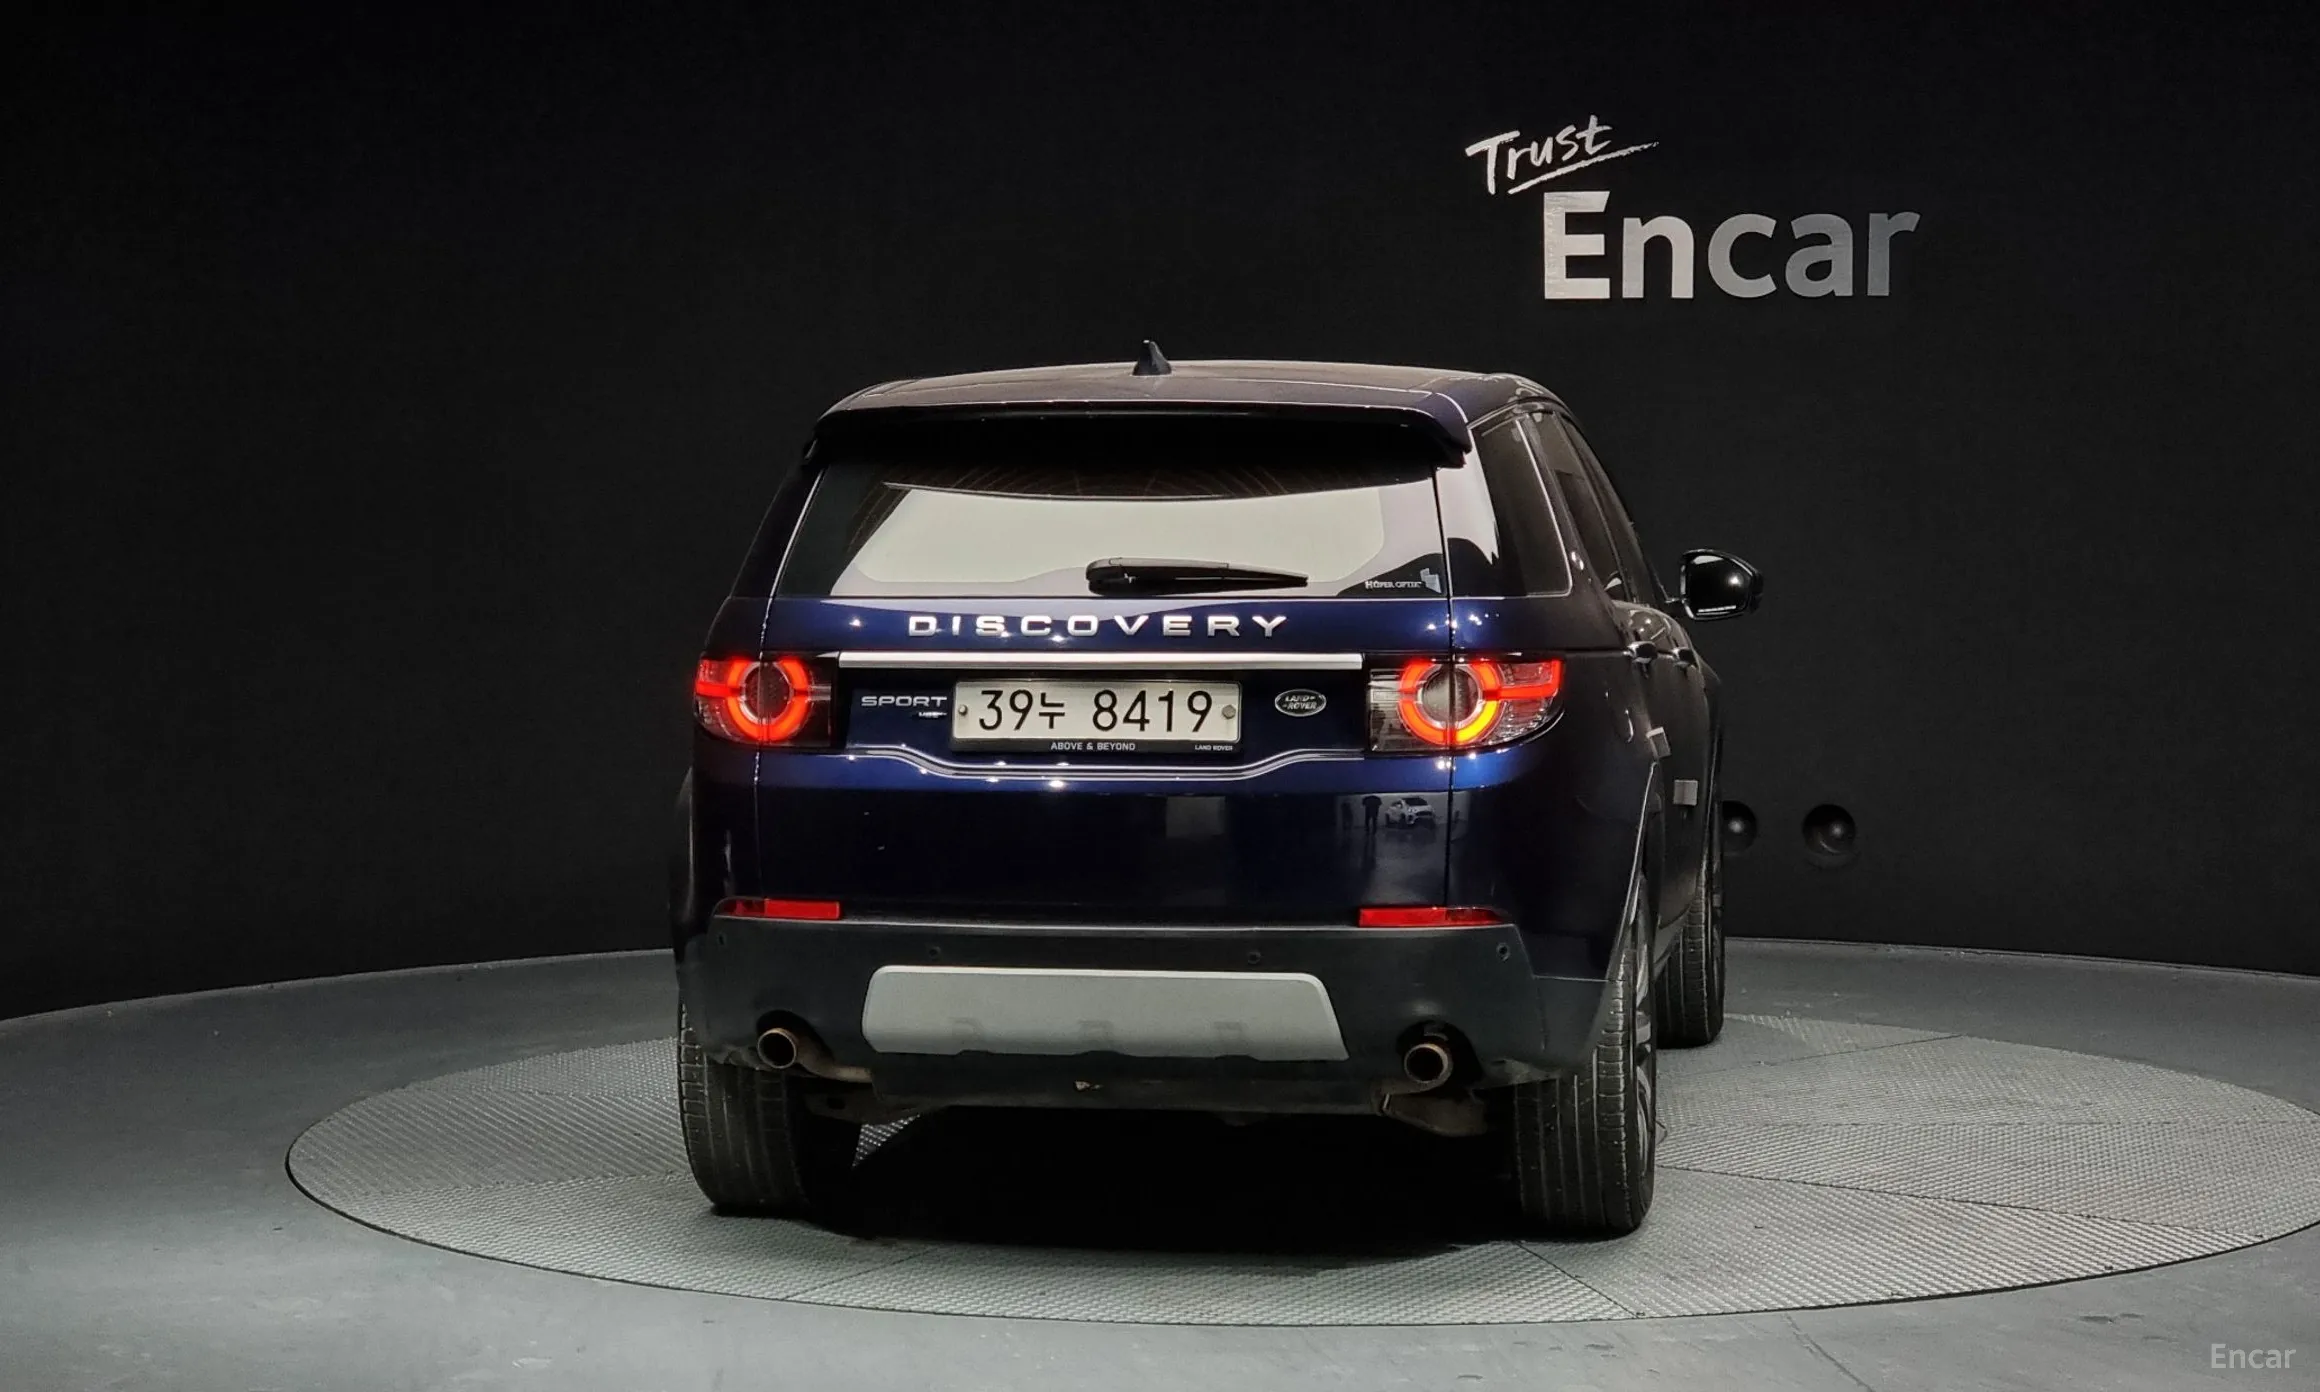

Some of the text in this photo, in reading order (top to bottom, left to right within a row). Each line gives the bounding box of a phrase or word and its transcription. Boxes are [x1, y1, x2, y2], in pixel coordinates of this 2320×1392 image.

[1465, 114, 1613, 195] Trust
[1543, 190, 1921, 300] Encar
[908, 615, 1288, 637] DISCOVERY
[861, 695, 948, 707] SPORT
[978, 690, 1213, 732] 39누 8419
[1050, 742, 1136, 751] ABOVE & BEYOND
